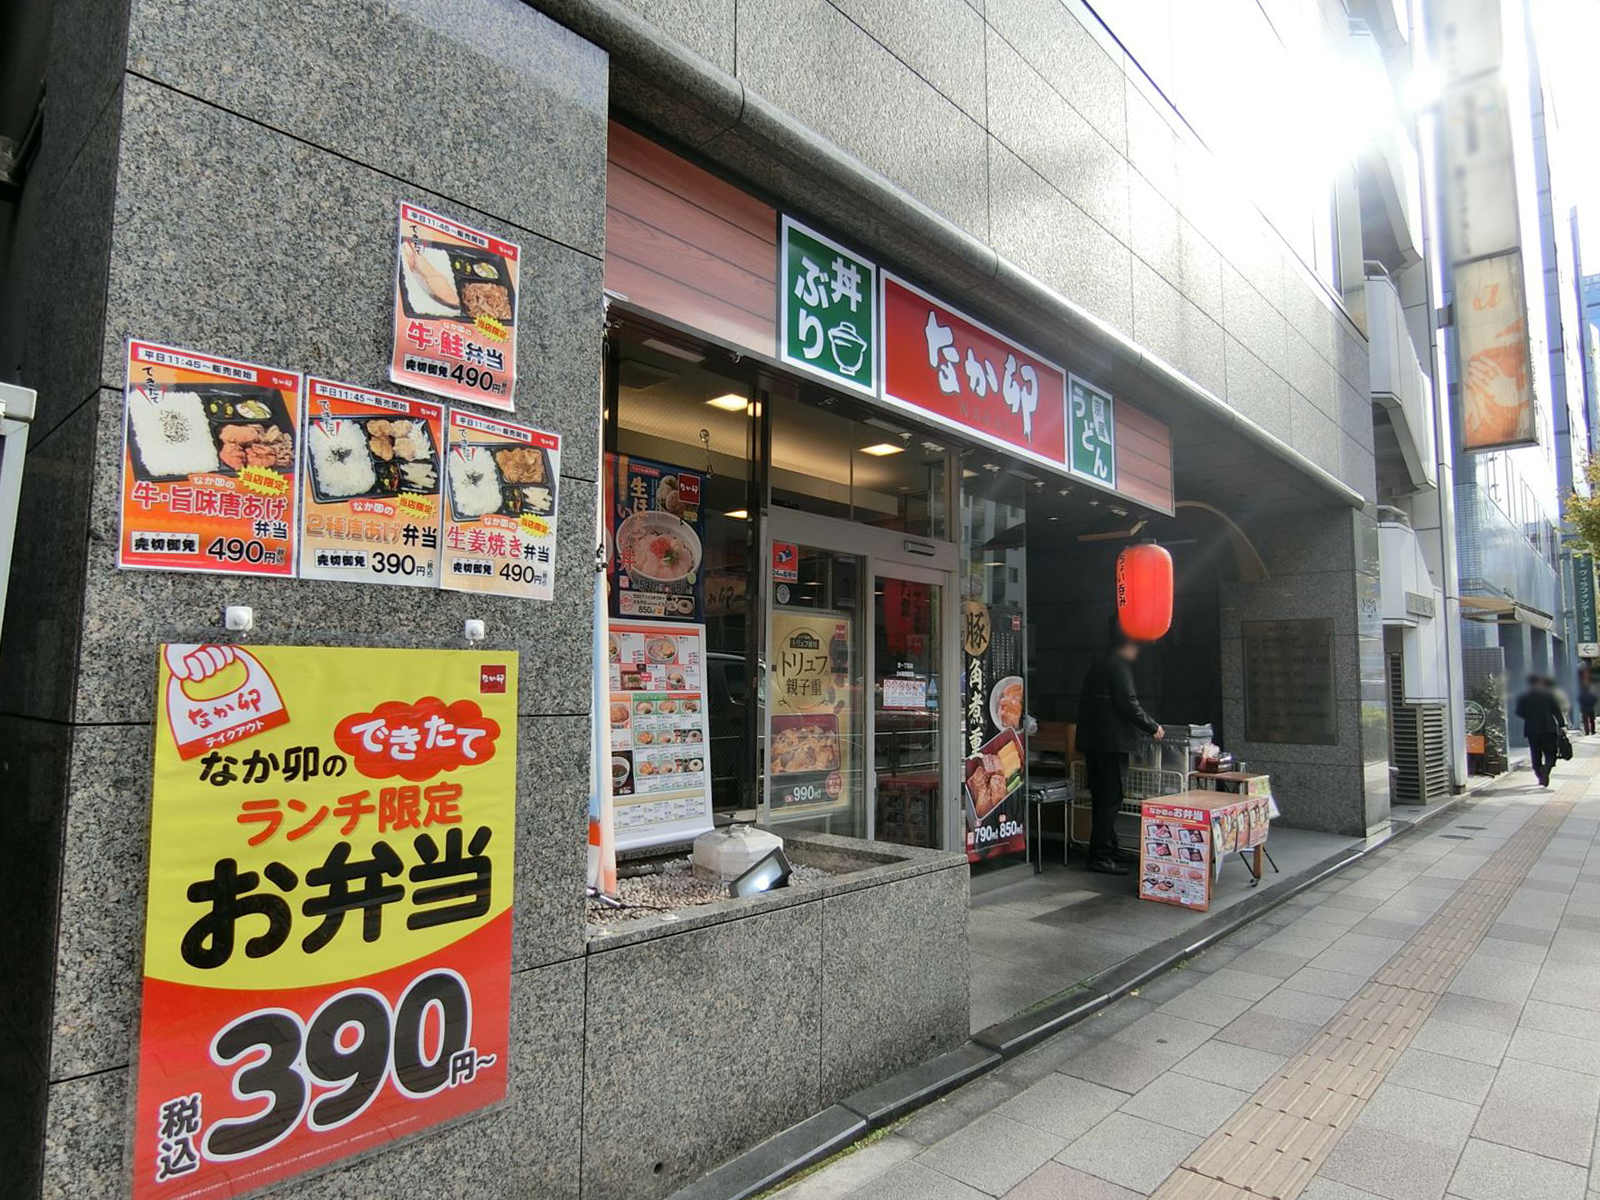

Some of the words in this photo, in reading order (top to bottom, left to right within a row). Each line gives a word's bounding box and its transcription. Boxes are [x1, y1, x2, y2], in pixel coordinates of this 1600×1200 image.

[450, 363, 501, 395] 490円
[924, 310, 1039, 446] なか卯
[1072, 386, 1108, 479] うどん
[242, 469, 285, 492] 当店限定
[133, 481, 287, 521] 牛・旨味唐あげ
[400, 497, 434, 515] 当店限定
[134, 536, 196, 552] 売切御免
[254, 519, 288, 540] 弁当
[207, 537, 277, 565] 490円
[317, 554, 366, 568] 売切御免
[371, 551, 426, 577] 390円
[452, 561, 493, 576] 売切御免
[499, 562, 542, 585] 490円
[965, 611, 988, 650] 豚
[481, 673, 505, 685] なか卯
[785, 677, 823, 697] 親子重
[187, 688, 262, 728] なか卯
[967, 657, 985, 759] 角煮重
[206, 718, 266, 749] テイクアウト
[351, 714, 487, 761] できたて
[199, 746, 348, 787] なか卯の
[236, 781, 464, 847] ランチ限定
[180, 826, 493, 970] お弁当
[156, 1093, 202, 1183] 税込
